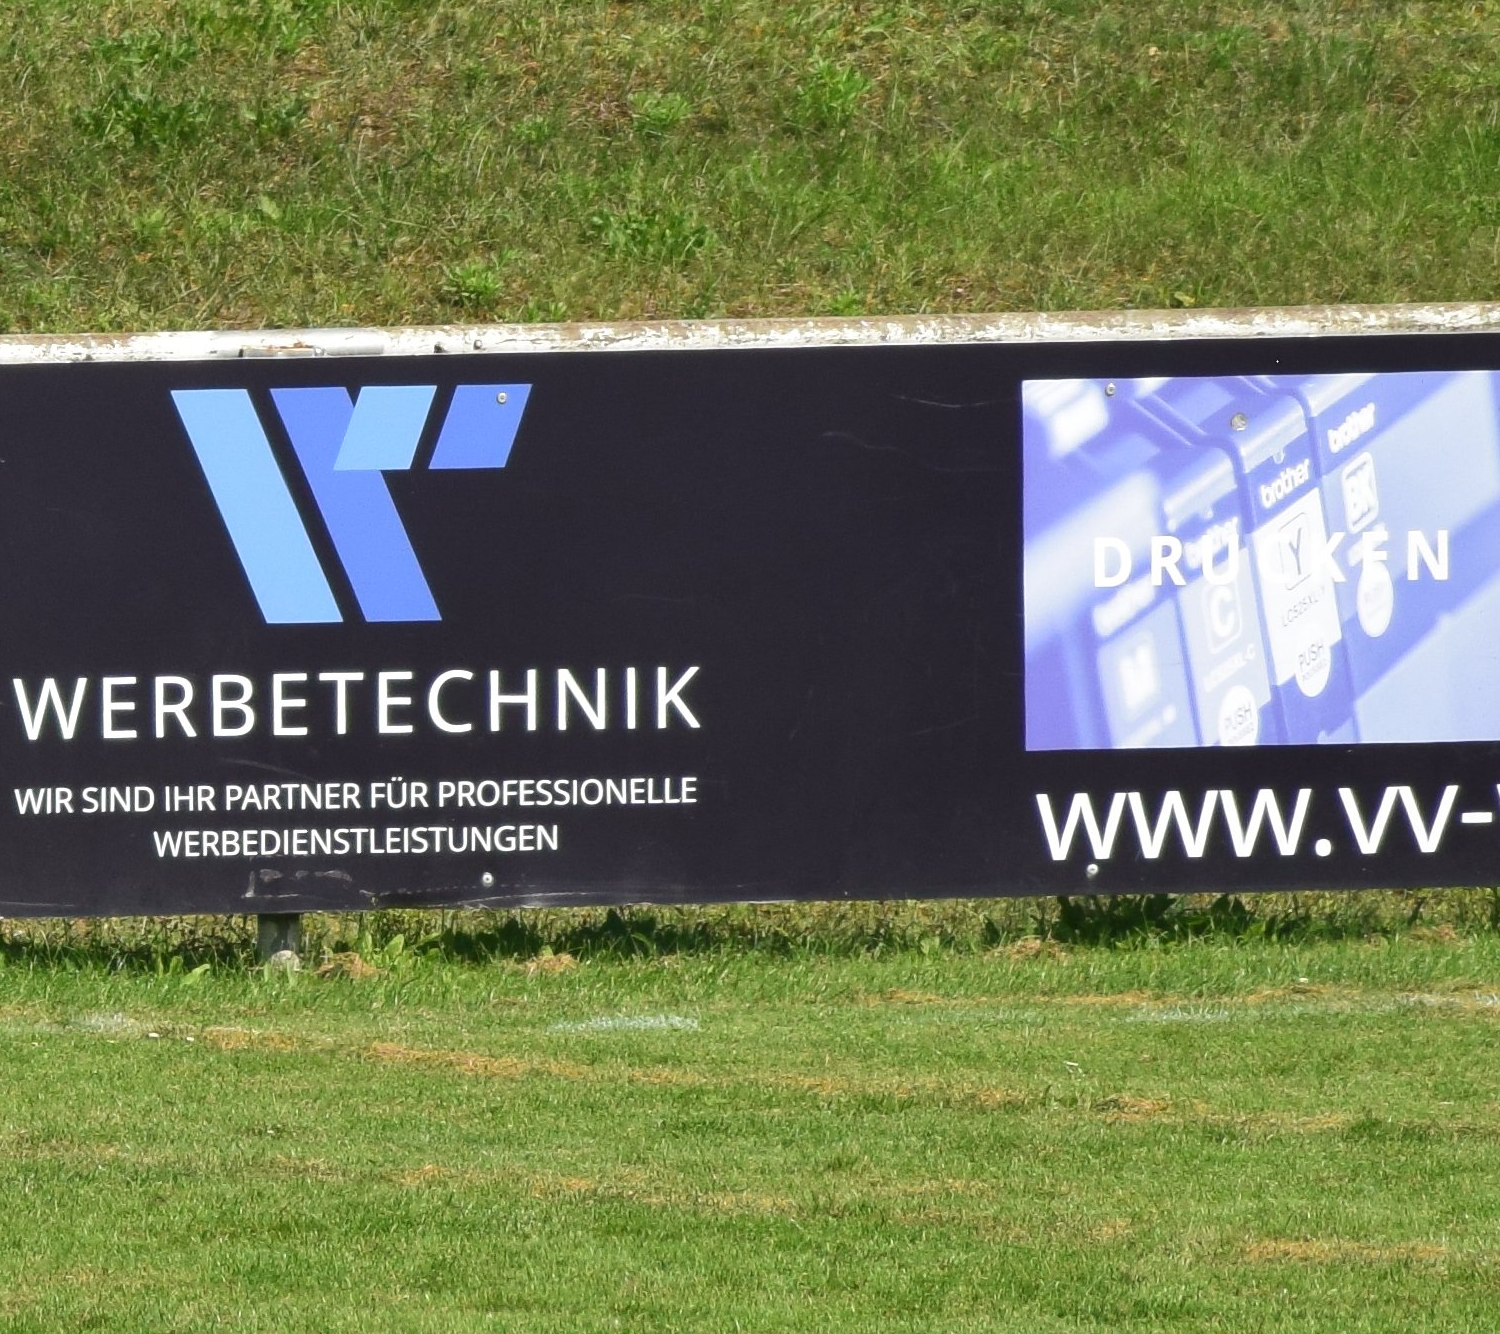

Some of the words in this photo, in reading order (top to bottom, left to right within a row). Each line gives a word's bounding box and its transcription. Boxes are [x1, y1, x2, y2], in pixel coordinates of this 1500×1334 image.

[1260, 459, 1310, 508] brother
[1288, 527, 1302, 576] Y
[1297, 639, 1325, 670] PUSH
[12, 665, 702, 741] WERBETECHNIK
[13, 785, 75, 815] WIR
[81, 783, 156, 813] SIND
[164, 783, 216, 812] IHR
[225, 781, 362, 811] PARTNER
[370, 776, 430, 809] FÜR
[438, 776, 698, 808] PROFESSIONELLE
[152, 824, 559, 858] WERBEDIENSTLEISTUNGEN
